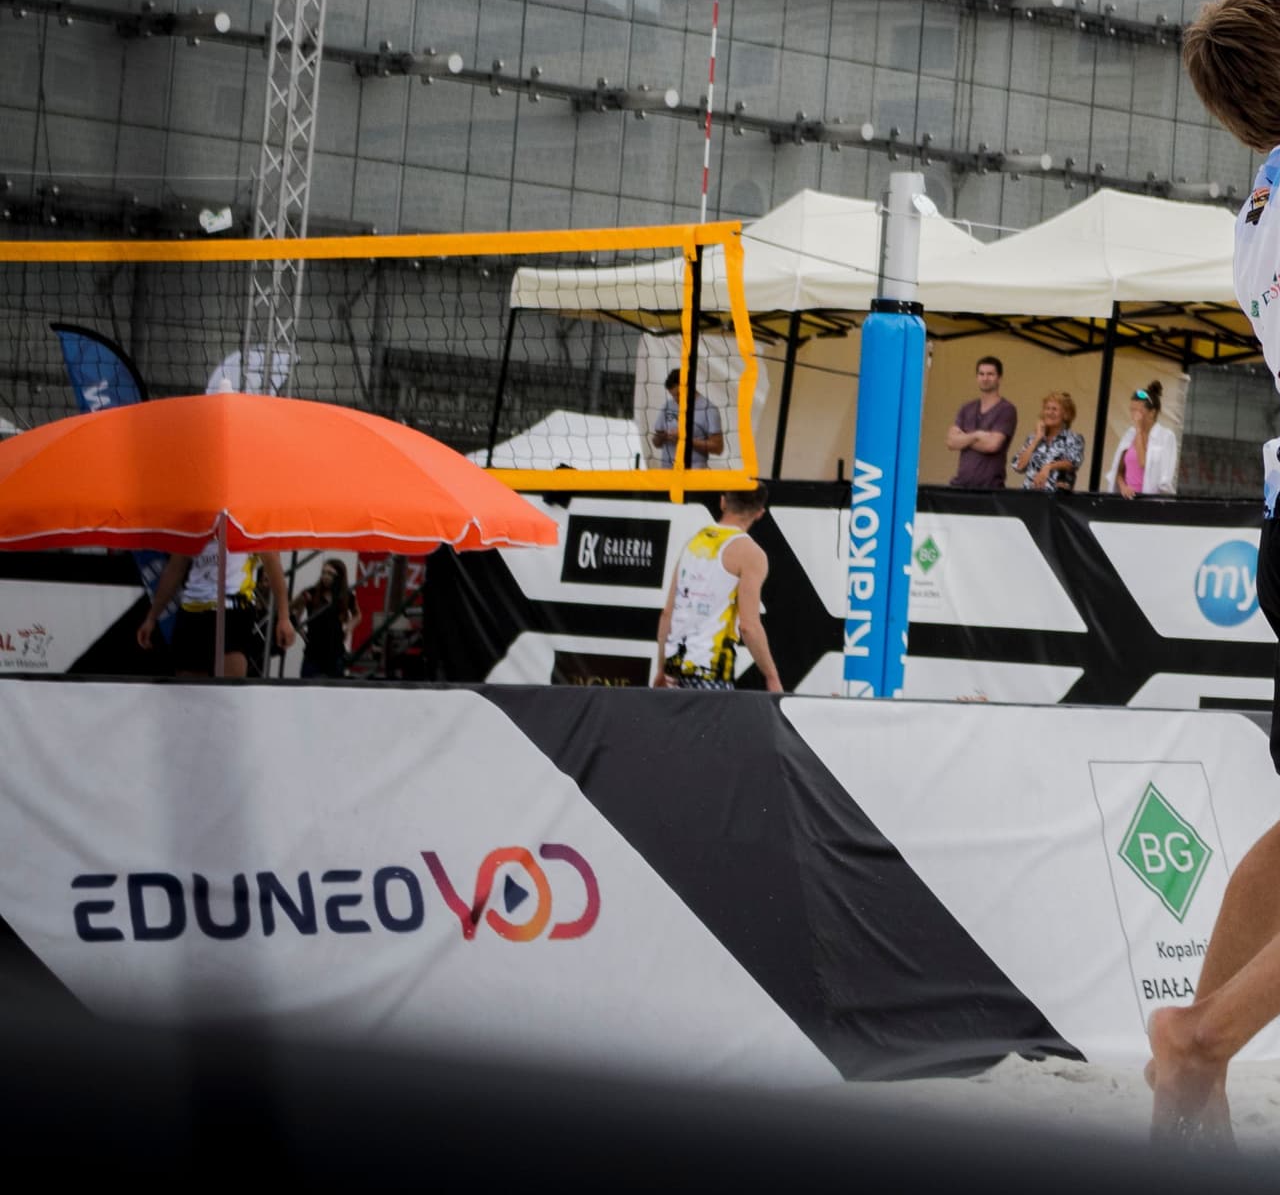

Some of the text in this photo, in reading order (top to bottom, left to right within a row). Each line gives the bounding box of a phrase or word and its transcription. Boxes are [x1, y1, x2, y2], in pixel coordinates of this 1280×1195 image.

[604, 537, 653, 557] GALERIA
[1138, 832, 1195, 874] BG
[1142, 976, 1195, 1000] BIAŁA
